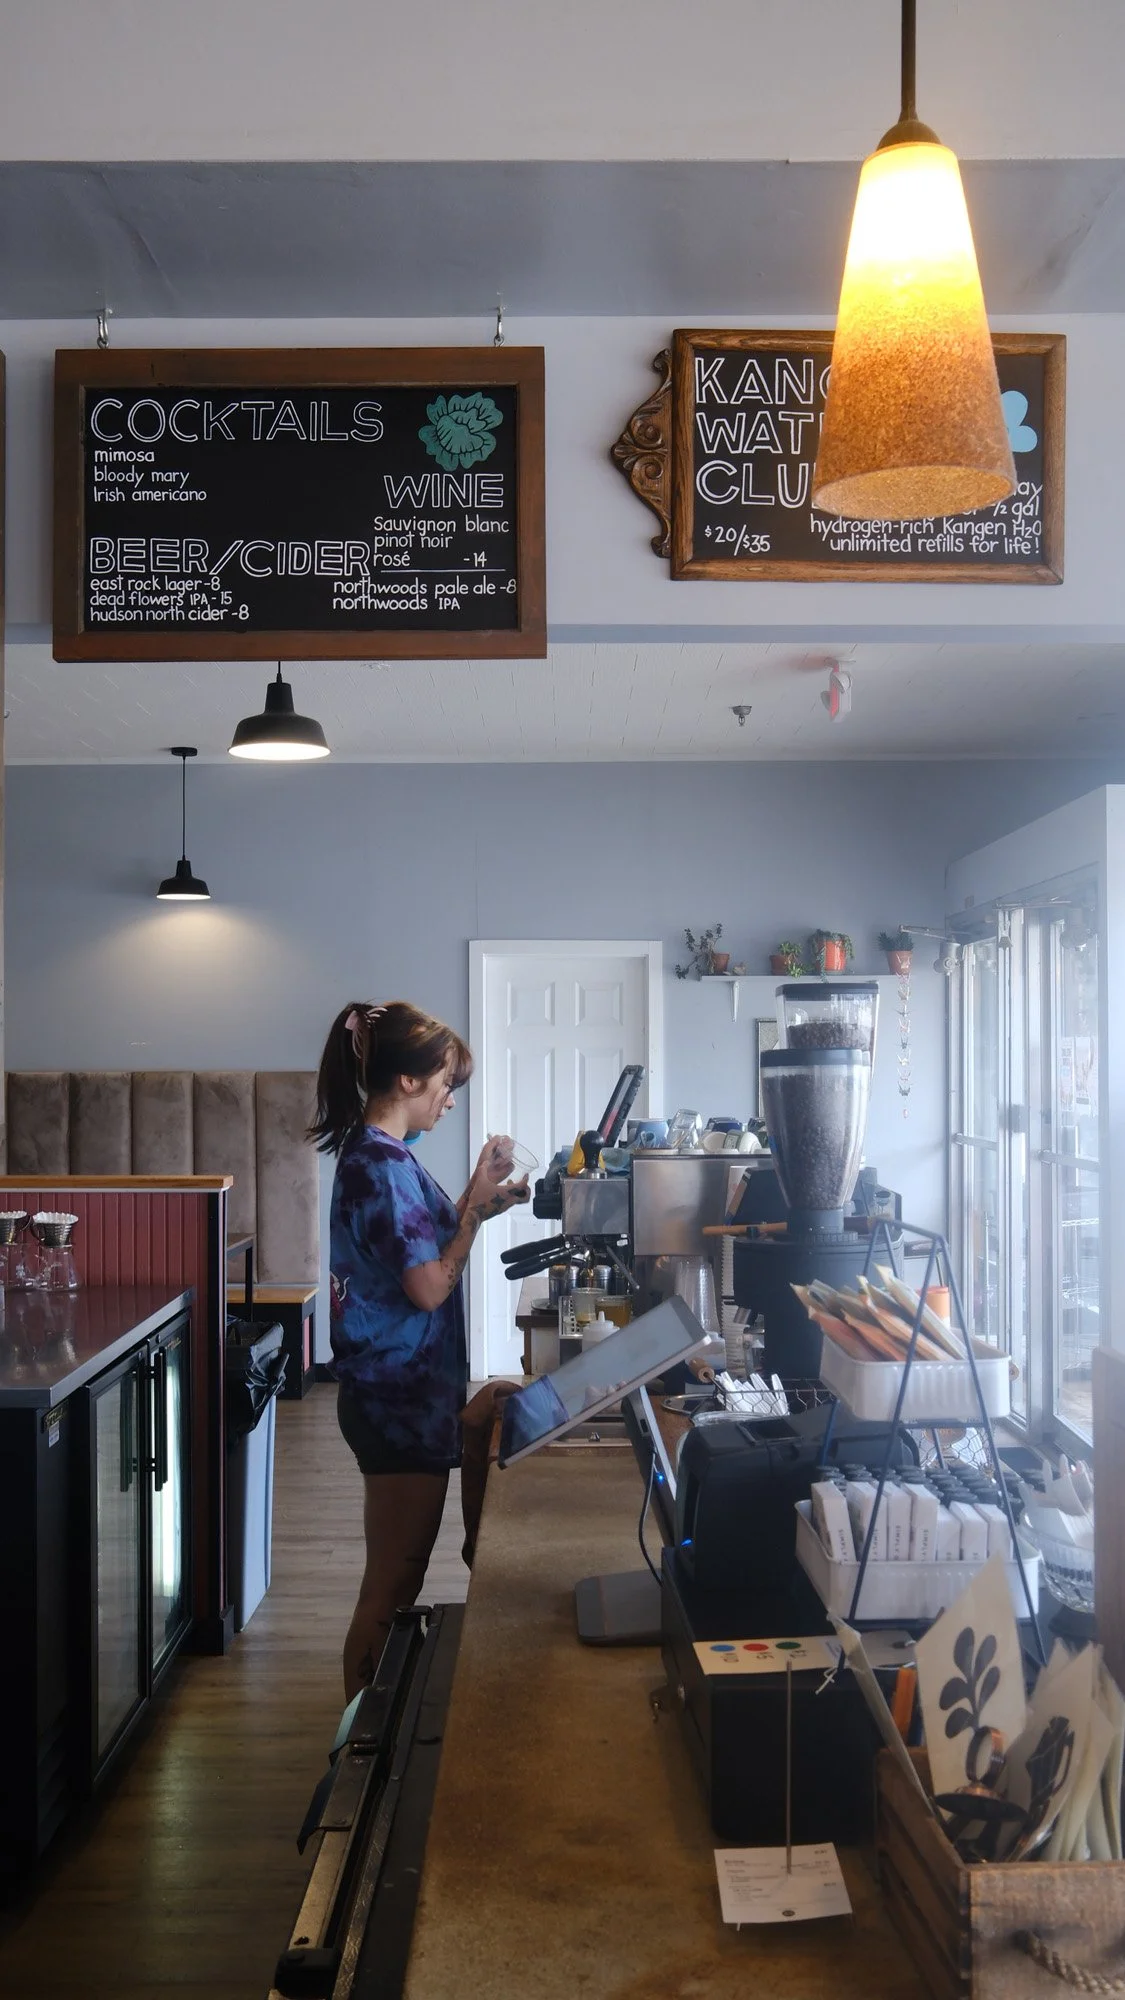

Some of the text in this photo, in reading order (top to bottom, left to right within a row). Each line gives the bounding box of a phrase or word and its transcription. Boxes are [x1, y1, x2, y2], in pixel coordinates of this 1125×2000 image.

[90, 398, 384, 442] COCKTAILS
[695, 411, 824, 455] WAT
[94, 447, 155, 462] mimosa
[94, 465, 190, 488] bloody mary
[696, 460, 820, 509] CLU
[93, 486, 207, 502] Irish americano
[383, 473, 504, 509] WINE
[1013, 481, 1043, 506] ay
[1011, 495, 1040, 525] gal
[374, 514, 510, 537] Sauvignon blanc
[809, 513, 934, 541] hydrogen-rich
[1013, 519, 1043, 539] H2O
[374, 530, 453, 554] pinot noir
[830, 534, 1041, 554] unlimited refills for life!
[90, 537, 371, 577] BEER/CIDER
[373, 551, 411, 567] rosé
[90, 575, 124, 591] east
[128, 575, 161, 591] rock
[333, 575, 428, 595] northwoods
[434, 575, 469, 599] pale
[473, 575, 496, 595] ale
[90, 591, 125, 606] dead
[130, 591, 184, 606] flowers
[190, 593, 208, 606] IPA
[332, 593, 461, 611] northwoods IPA
[90, 605, 143, 621] hudson
[146, 606, 185, 621] north
[188, 605, 229, 621] cider
